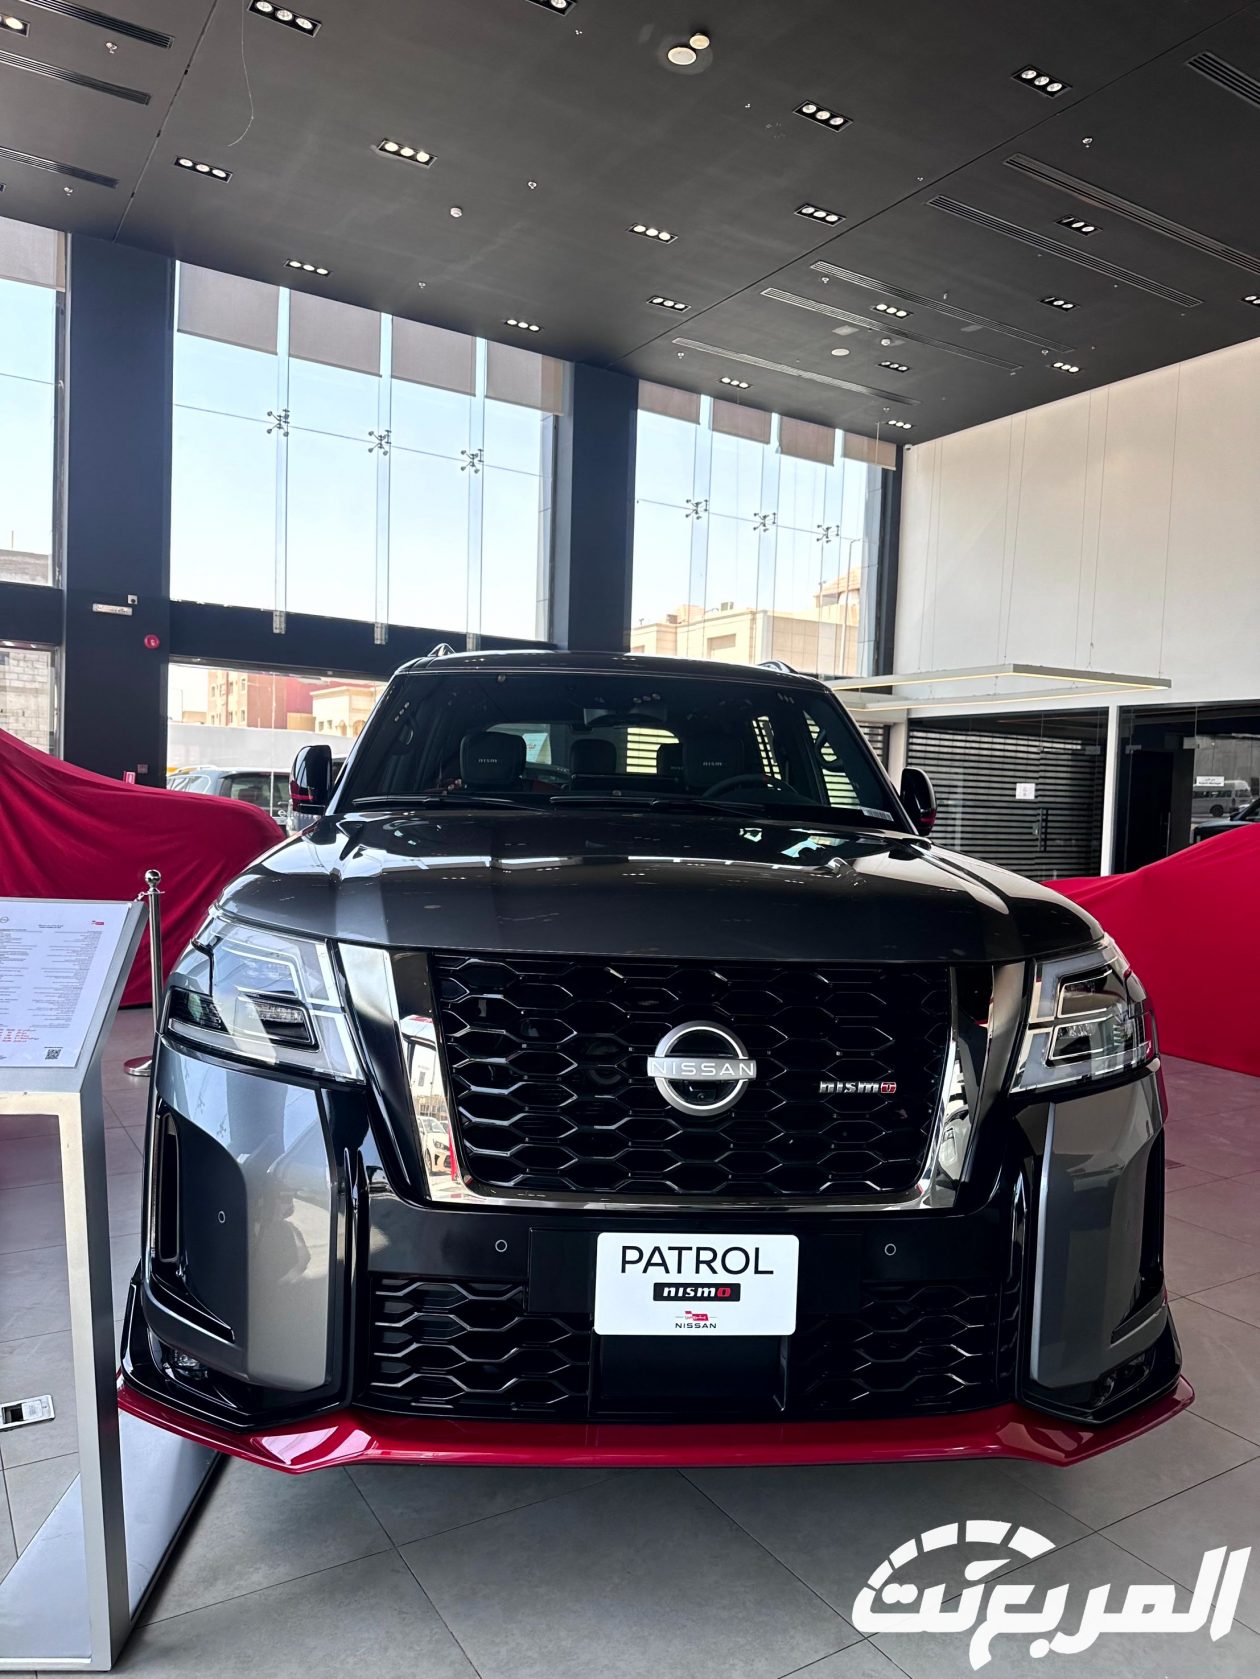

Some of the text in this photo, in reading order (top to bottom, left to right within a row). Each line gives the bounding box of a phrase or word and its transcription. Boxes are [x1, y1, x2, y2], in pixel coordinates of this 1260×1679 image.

[651, 1061, 754, 1076] NISSAN
[819, 1080, 897, 1094] nismo
[621, 1245, 774, 1275] PATROL
[662, 1286, 732, 1298] nismo
